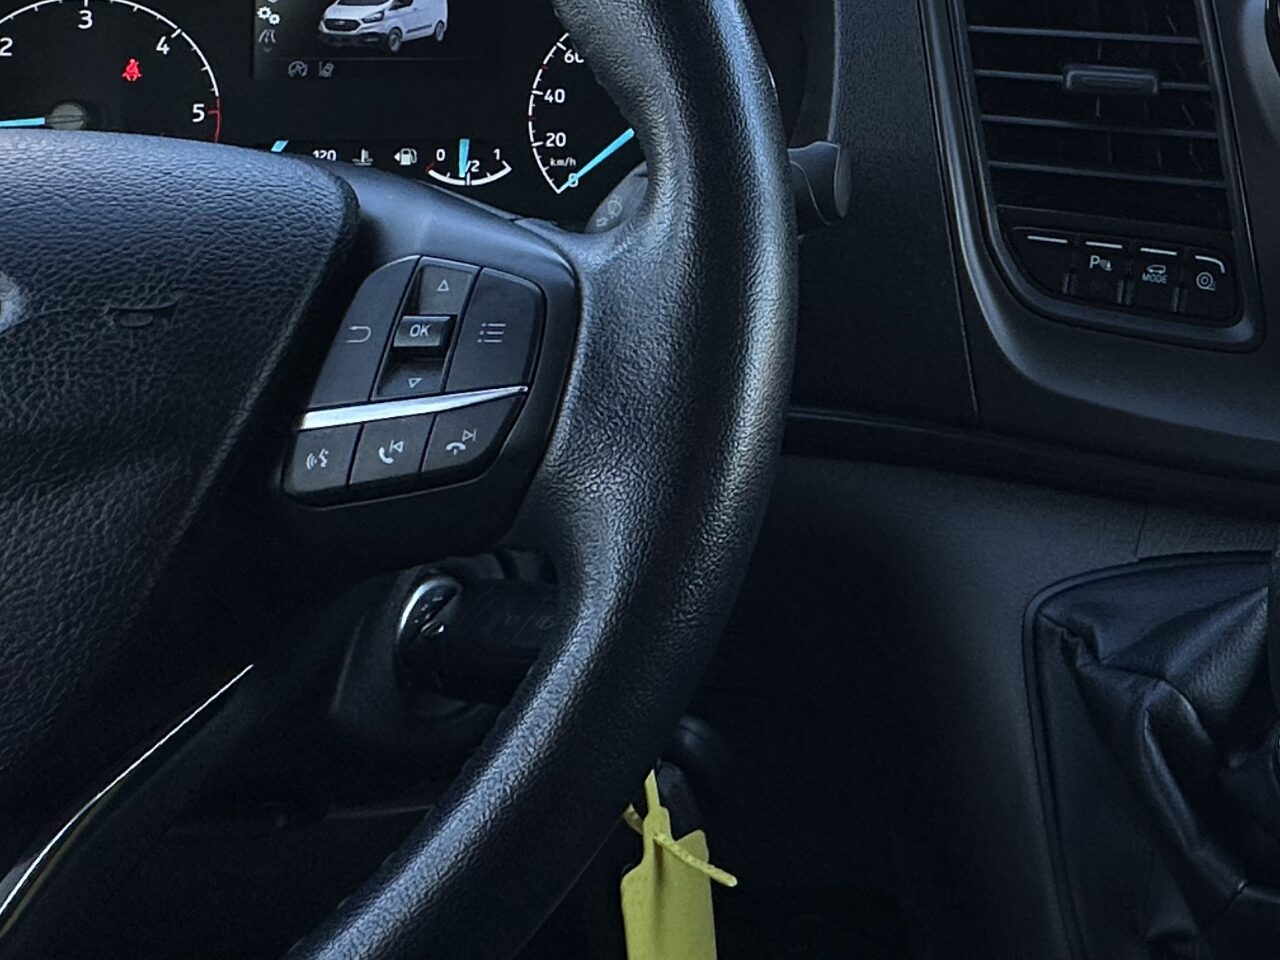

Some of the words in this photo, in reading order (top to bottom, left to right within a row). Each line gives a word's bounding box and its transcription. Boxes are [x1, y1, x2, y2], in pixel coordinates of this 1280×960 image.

[78, 10, 93, 29] 3
[156, 36, 170, 55] 4
[544, 89, 566, 104] 40
[192, 103, 205, 123] 5
[545, 132, 567, 147] 20
[436, 149, 446, 162] 0
[494, 148, 501, 161] 1
[550, 157, 577, 167] km/h
[1141, 272, 1169, 284] MODE
[409, 324, 432, 338] OK
